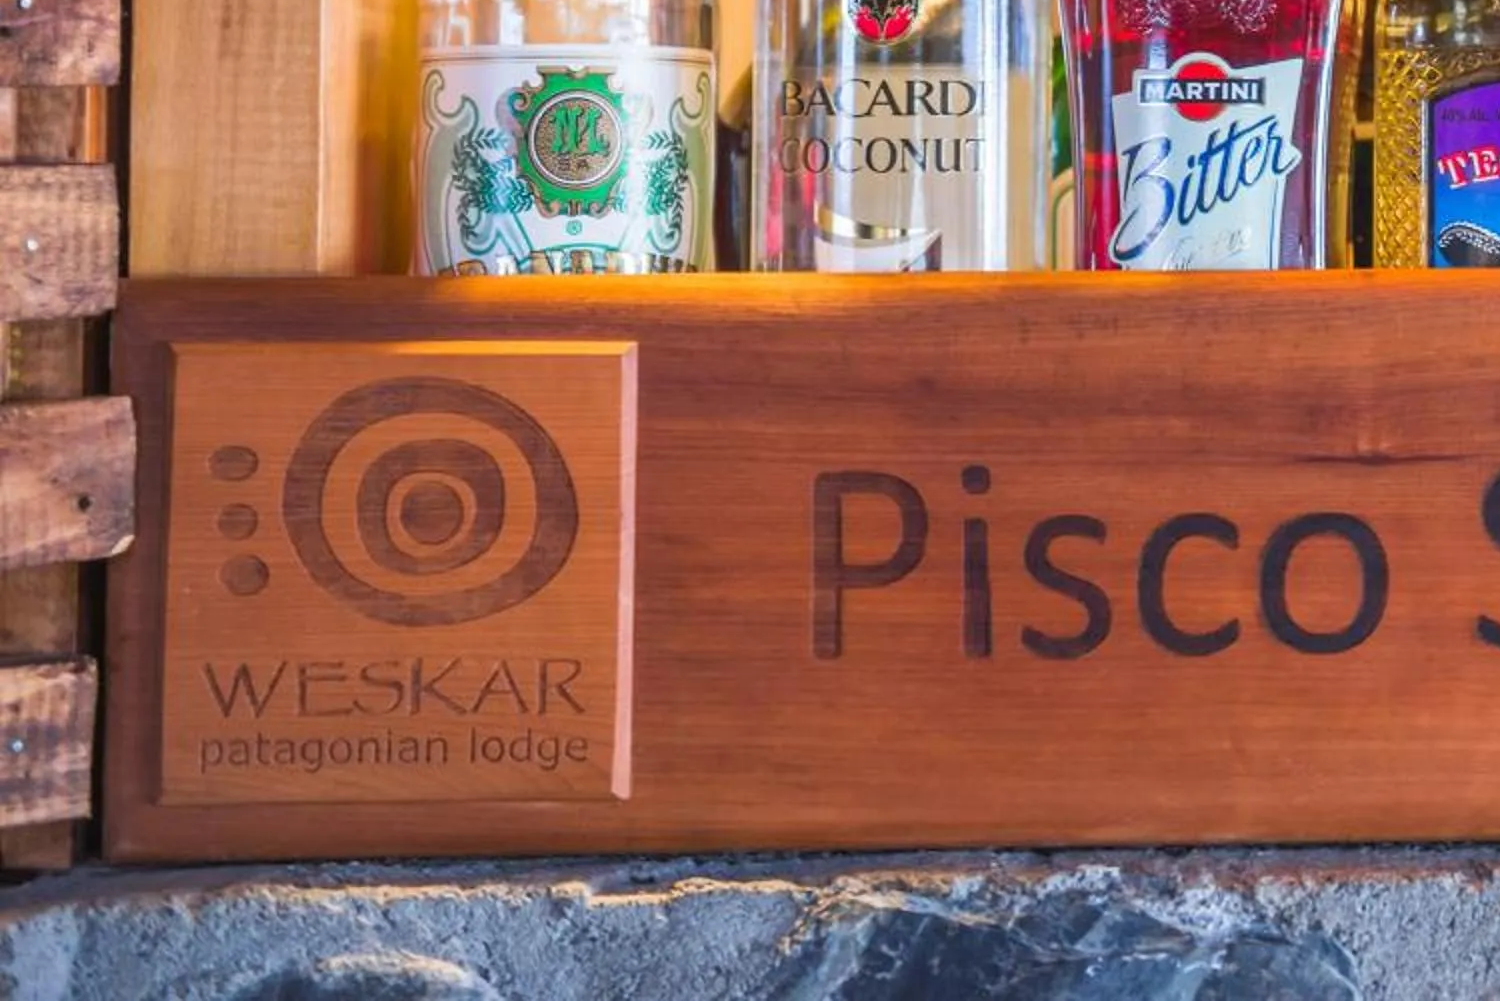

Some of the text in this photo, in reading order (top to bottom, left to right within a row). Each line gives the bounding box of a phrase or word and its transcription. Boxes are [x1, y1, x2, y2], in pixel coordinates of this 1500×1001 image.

[1144, 81, 1259, 100] MARTINI
[779, 137, 986, 174] COCONUT
[1113, 115, 1294, 261] Bitter
[813, 465, 1390, 660] Pisco
[205, 656, 587, 719] WESKAR
[201, 726, 589, 774] patagonian lodge
